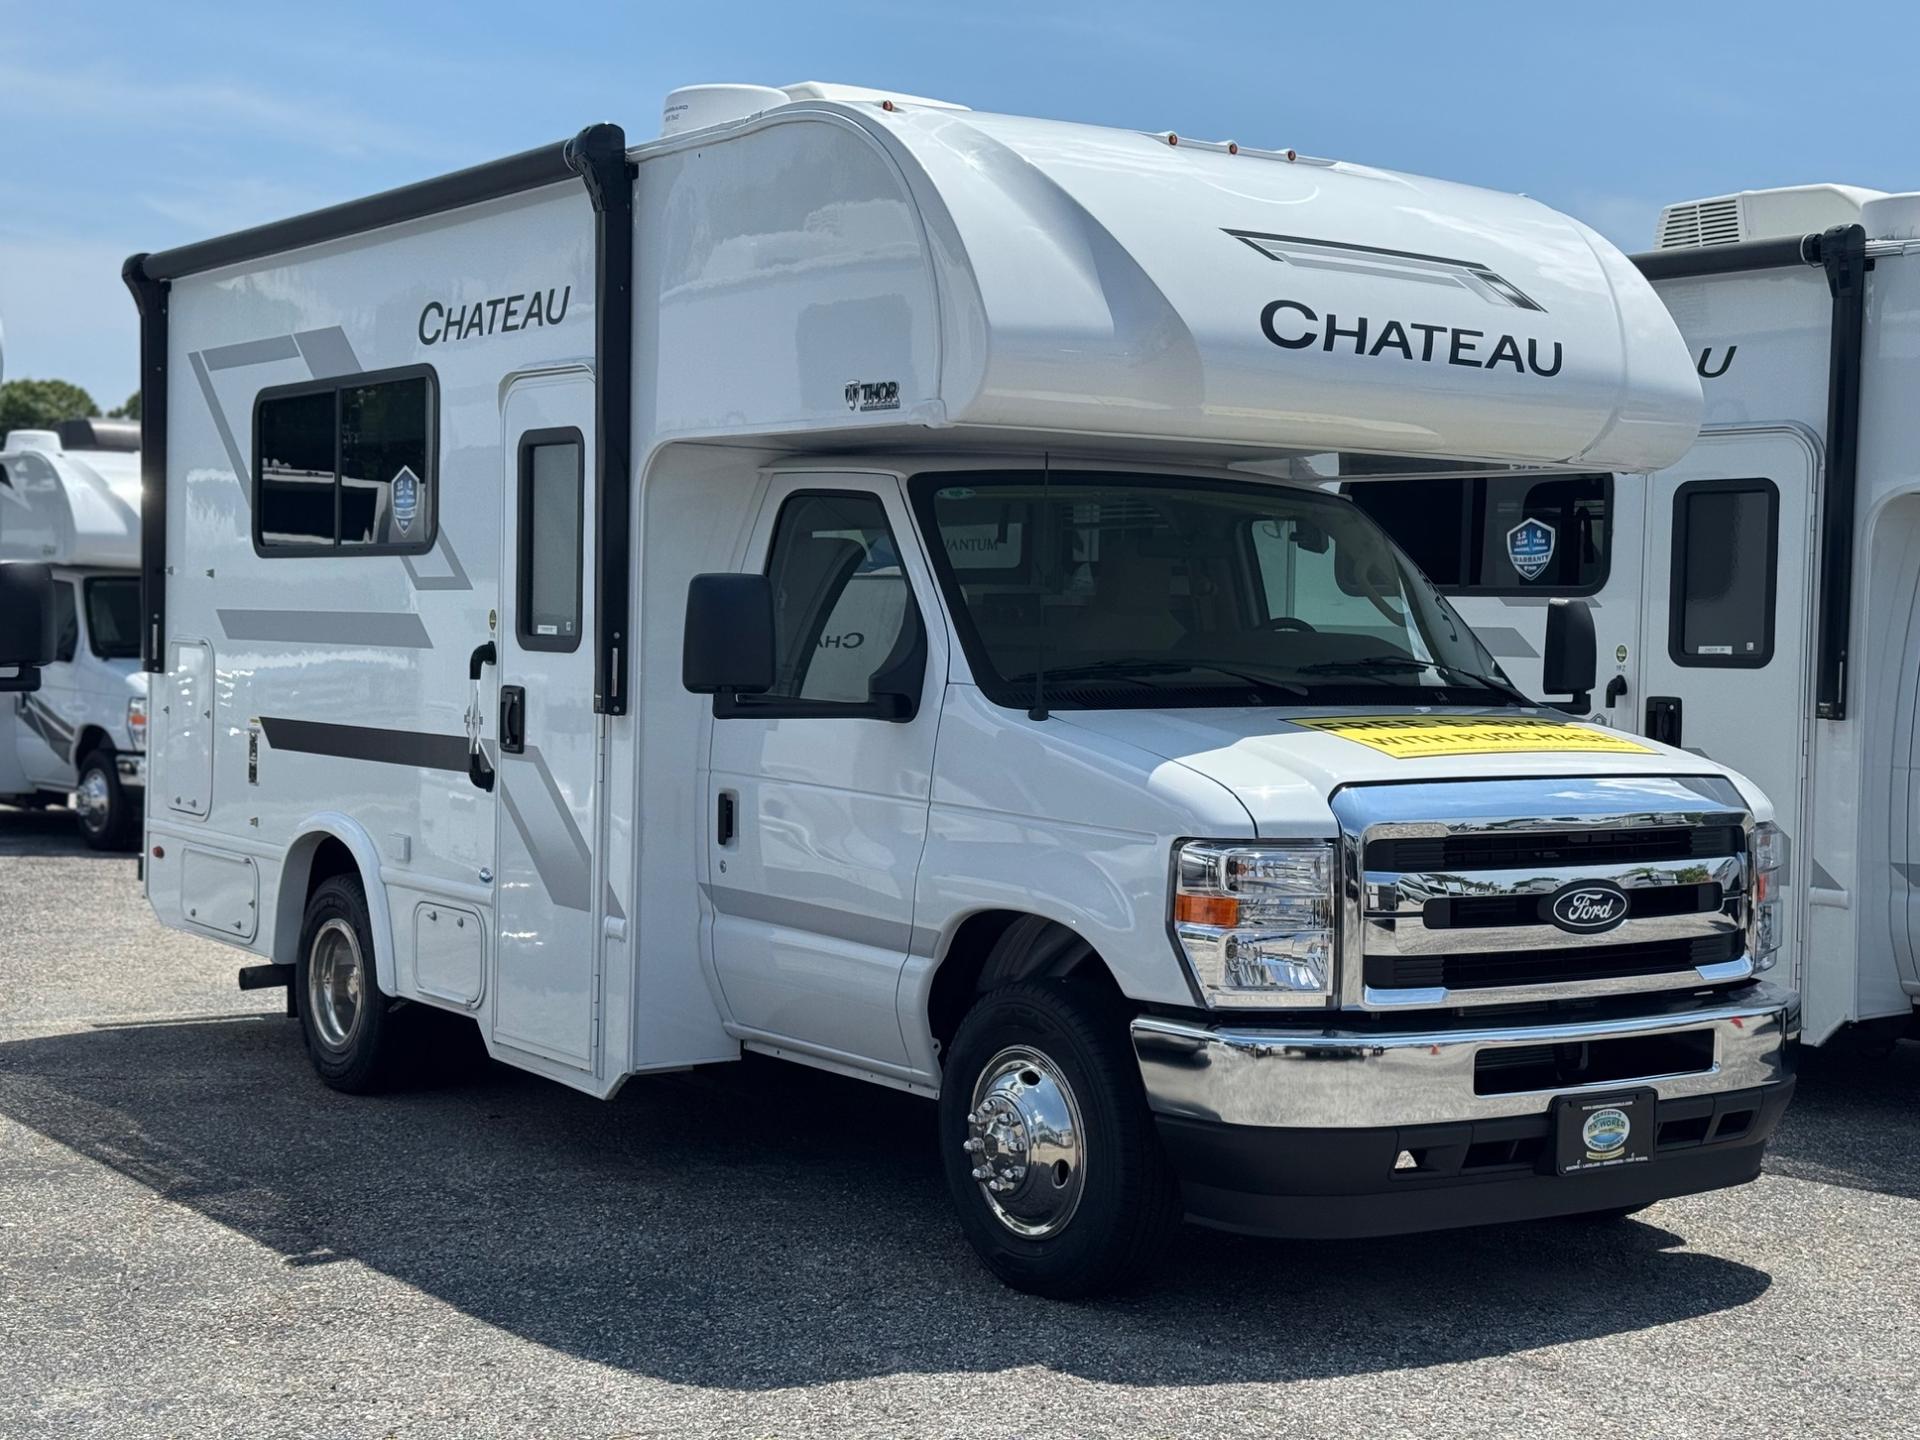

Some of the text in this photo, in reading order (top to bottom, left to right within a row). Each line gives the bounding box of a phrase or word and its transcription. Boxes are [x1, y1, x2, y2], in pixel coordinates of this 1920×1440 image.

[418, 285, 571, 345] CHATEAU
[1260, 299, 1563, 377] CHATEAU
[861, 381, 900, 404] THOR
[1310, 719, 1435, 732] FREE
[1361, 735, 1456, 746] WITH
[1568, 893, 1614, 920] Ford
[1600, 1119, 1626, 1130] WORLD
